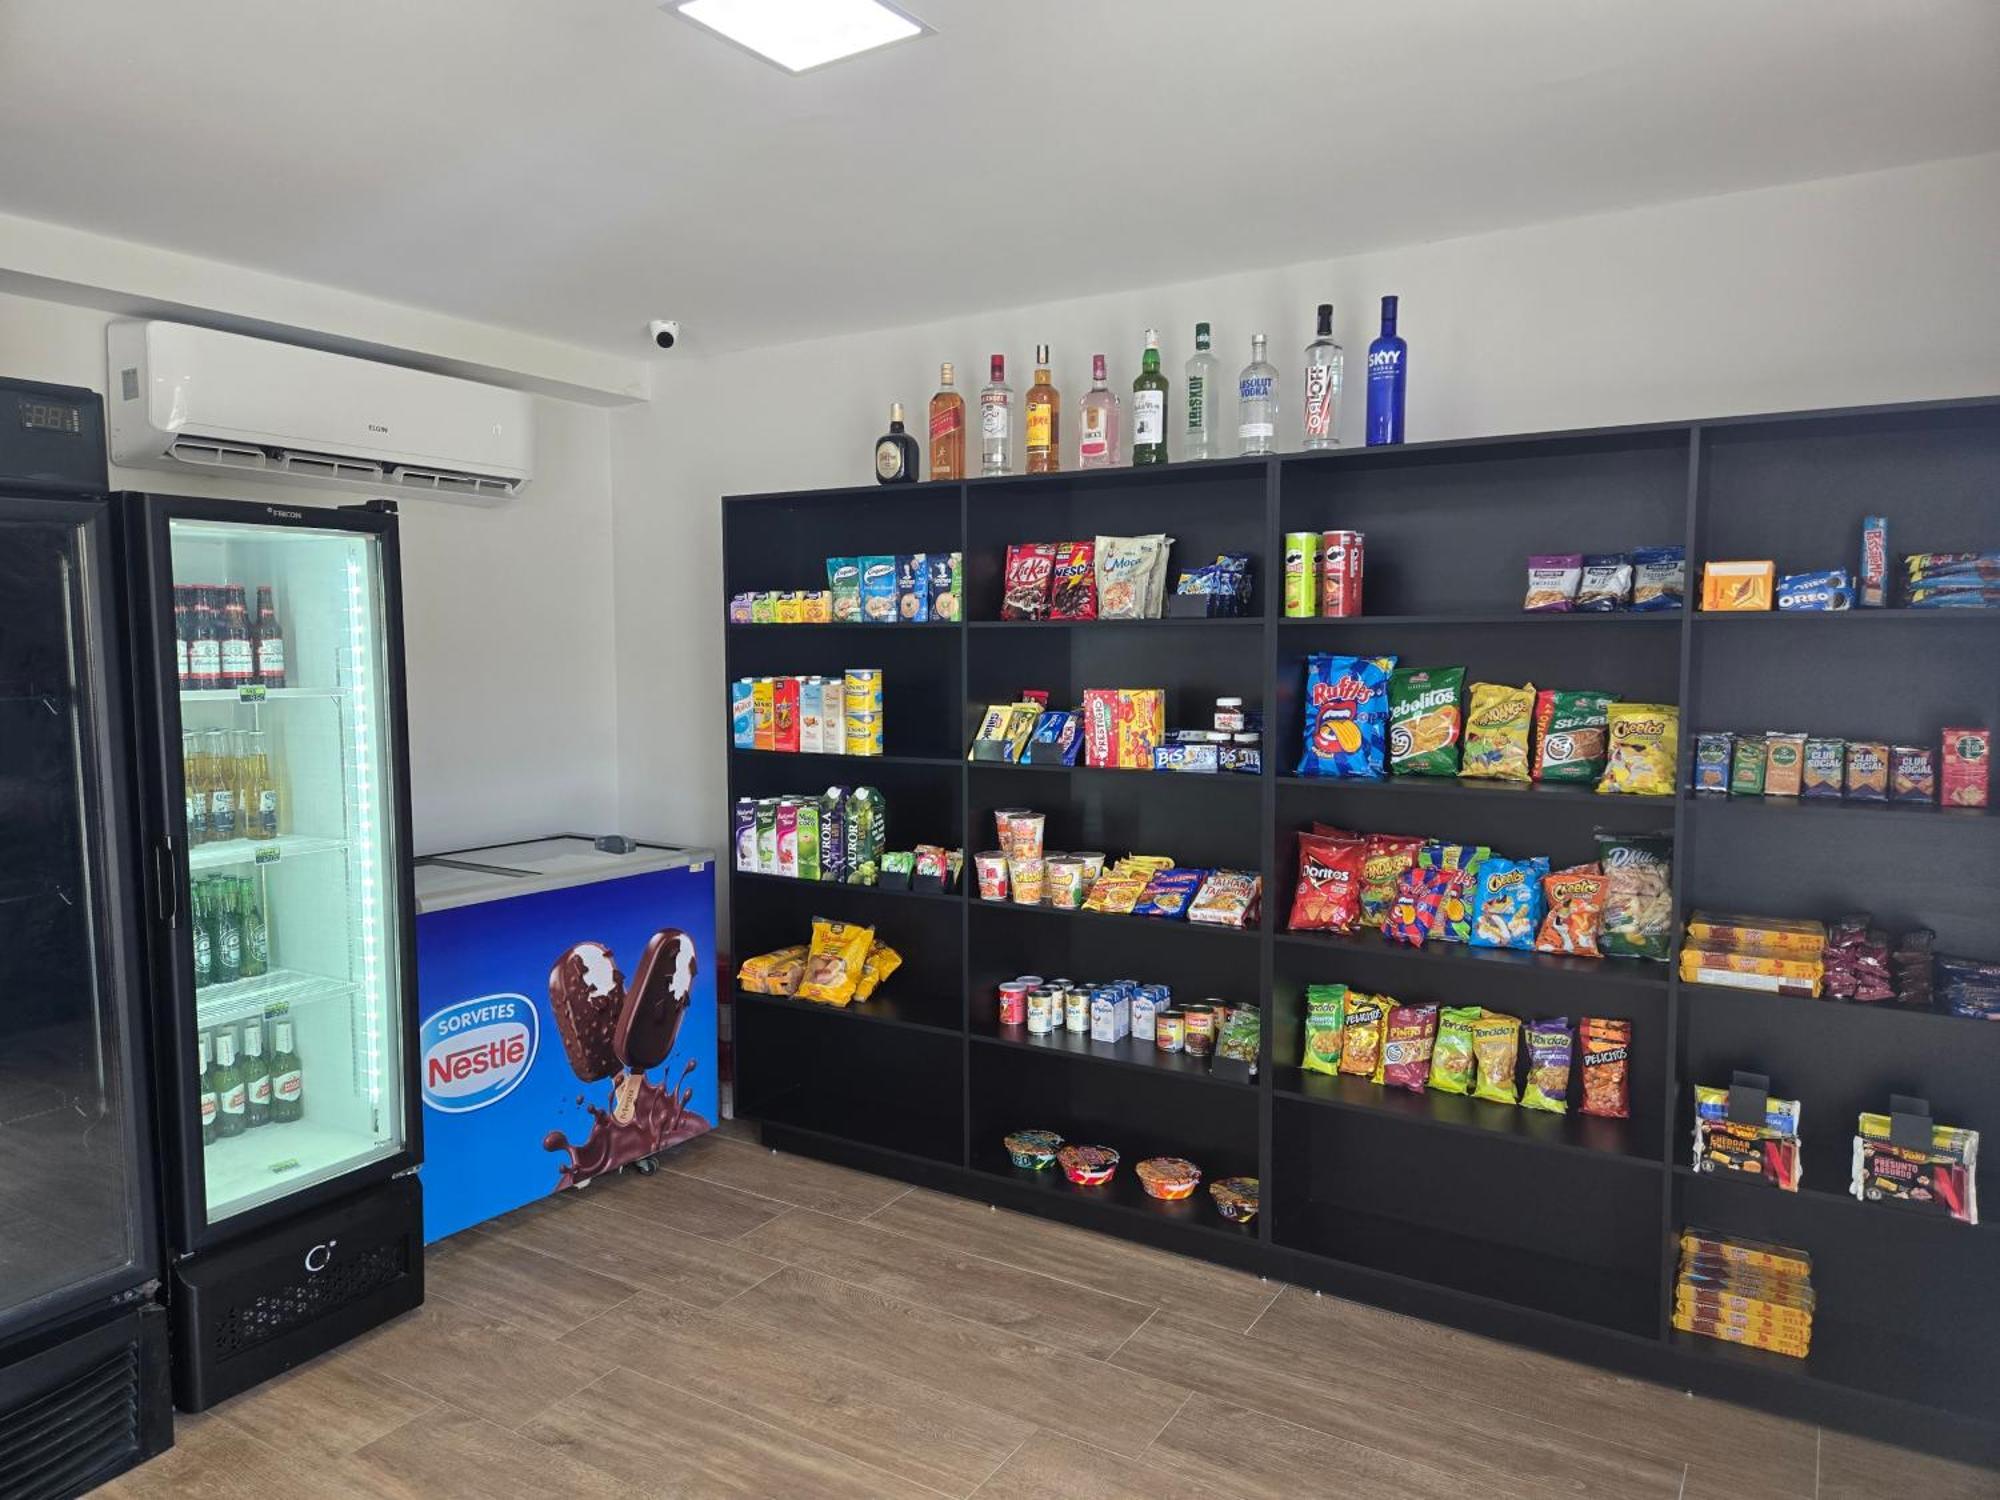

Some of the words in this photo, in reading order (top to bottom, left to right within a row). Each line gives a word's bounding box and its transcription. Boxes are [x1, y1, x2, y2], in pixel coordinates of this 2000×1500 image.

[1368, 350, 1401, 367] SKYY
[1241, 387, 1268, 398] VODKA
[1779, 592, 1829, 607] OREO
[1313, 676, 1374, 705] Ruffles
[1471, 702, 1527, 728] FANDANGOS
[980, 711, 999, 740] Galak
[1613, 721, 1665, 738] Cheetos
[1811, 751, 1835, 760] CLUB
[1854, 754, 1877, 762] CLUB
[1902, 758, 1927, 766] CLUB
[821, 812, 832, 868] AURORA
[847, 814, 858, 870] AURORA
[1303, 865, 1349, 881] Doritos
[1365, 855, 1412, 880] FANDANGOS
[1488, 869, 1526, 892] Cheetos
[1553, 880, 1600, 899] Cheetos
[438, 1003, 515, 1036] SORVETES
[1475, 1027, 1510, 1038] Torcida
[1532, 1034, 1569, 1046] Torcida
[428, 1033, 525, 1088] Nestlé
